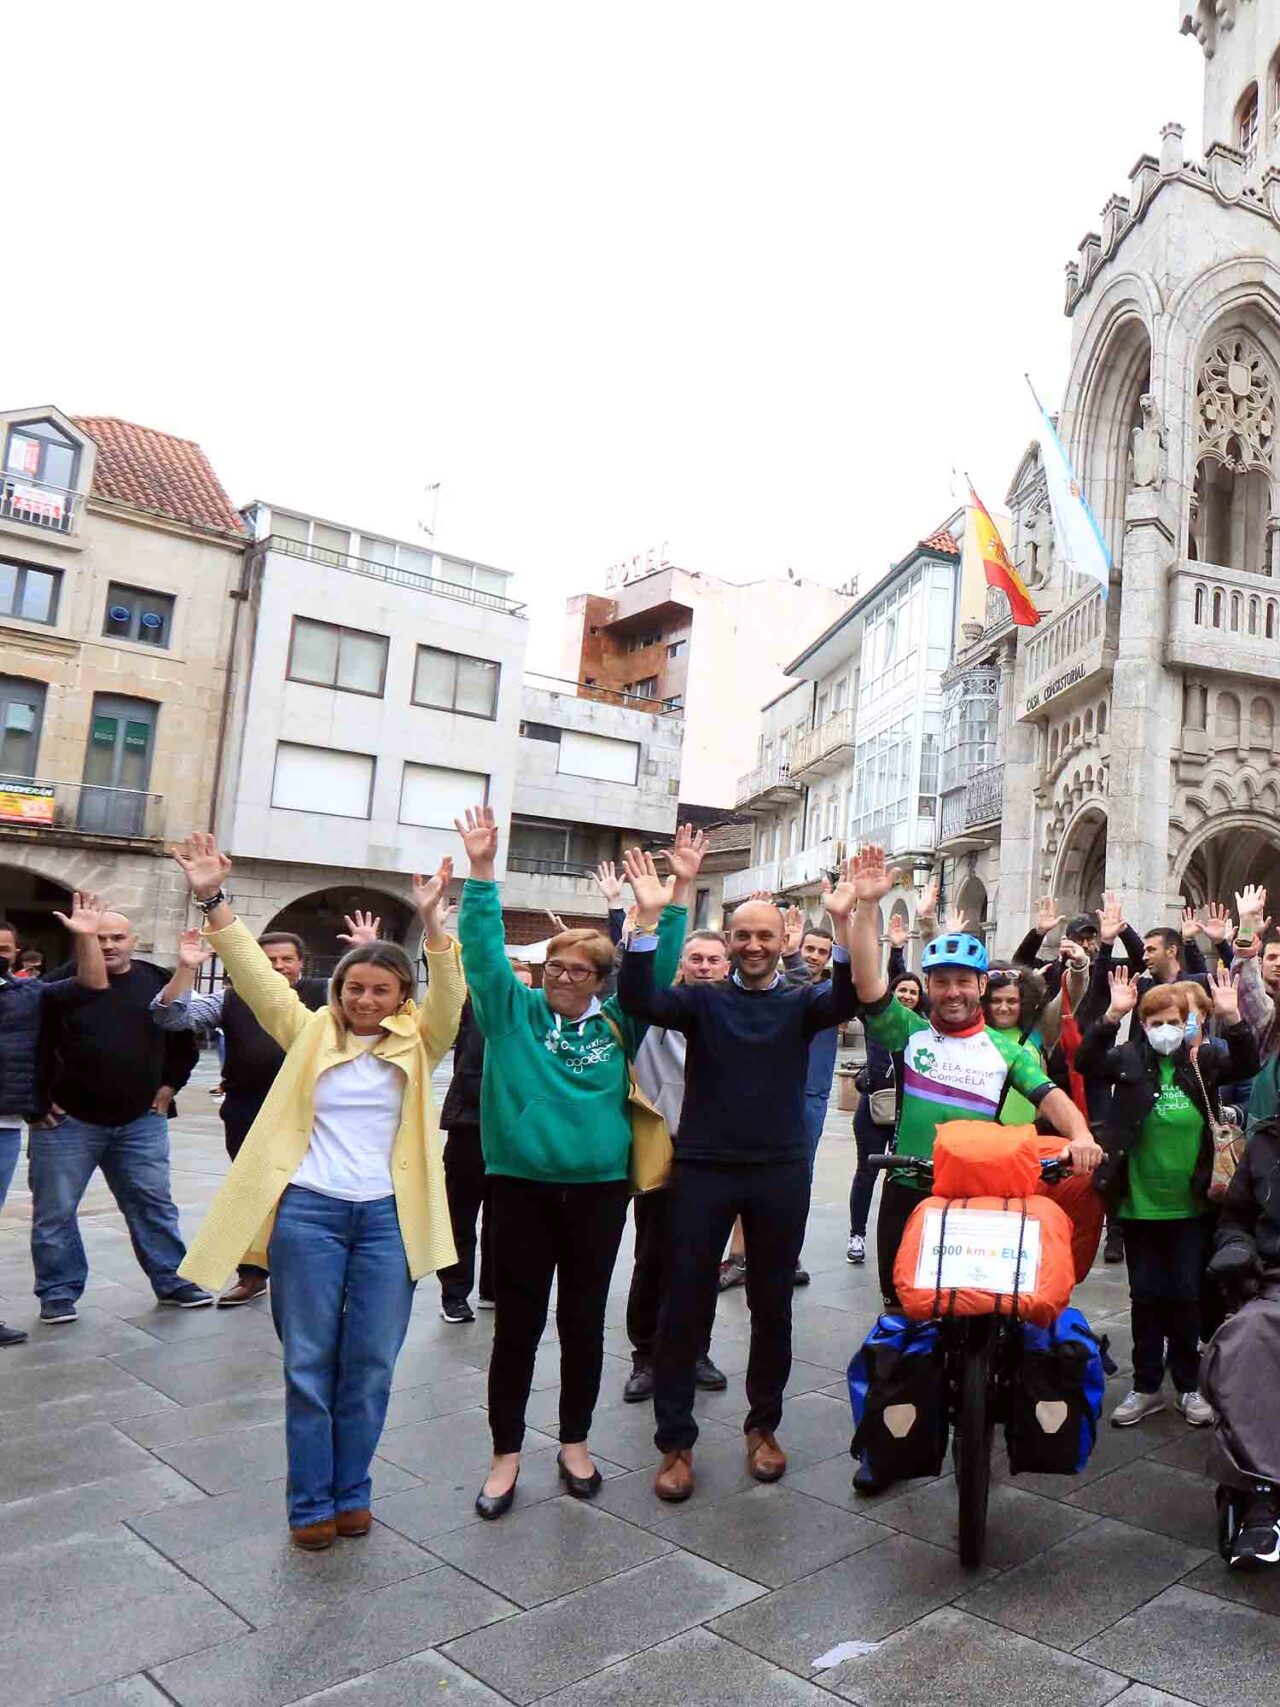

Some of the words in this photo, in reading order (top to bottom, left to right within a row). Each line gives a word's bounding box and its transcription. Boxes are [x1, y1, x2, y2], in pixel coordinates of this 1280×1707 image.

[1026, 694, 1040, 711] CASA
[942, 1062, 962, 1073] ELA
[932, 1245, 963, 1256] 6000
[966, 1246, 986, 1257] km
[1001, 1248, 1029, 1261] ELA
